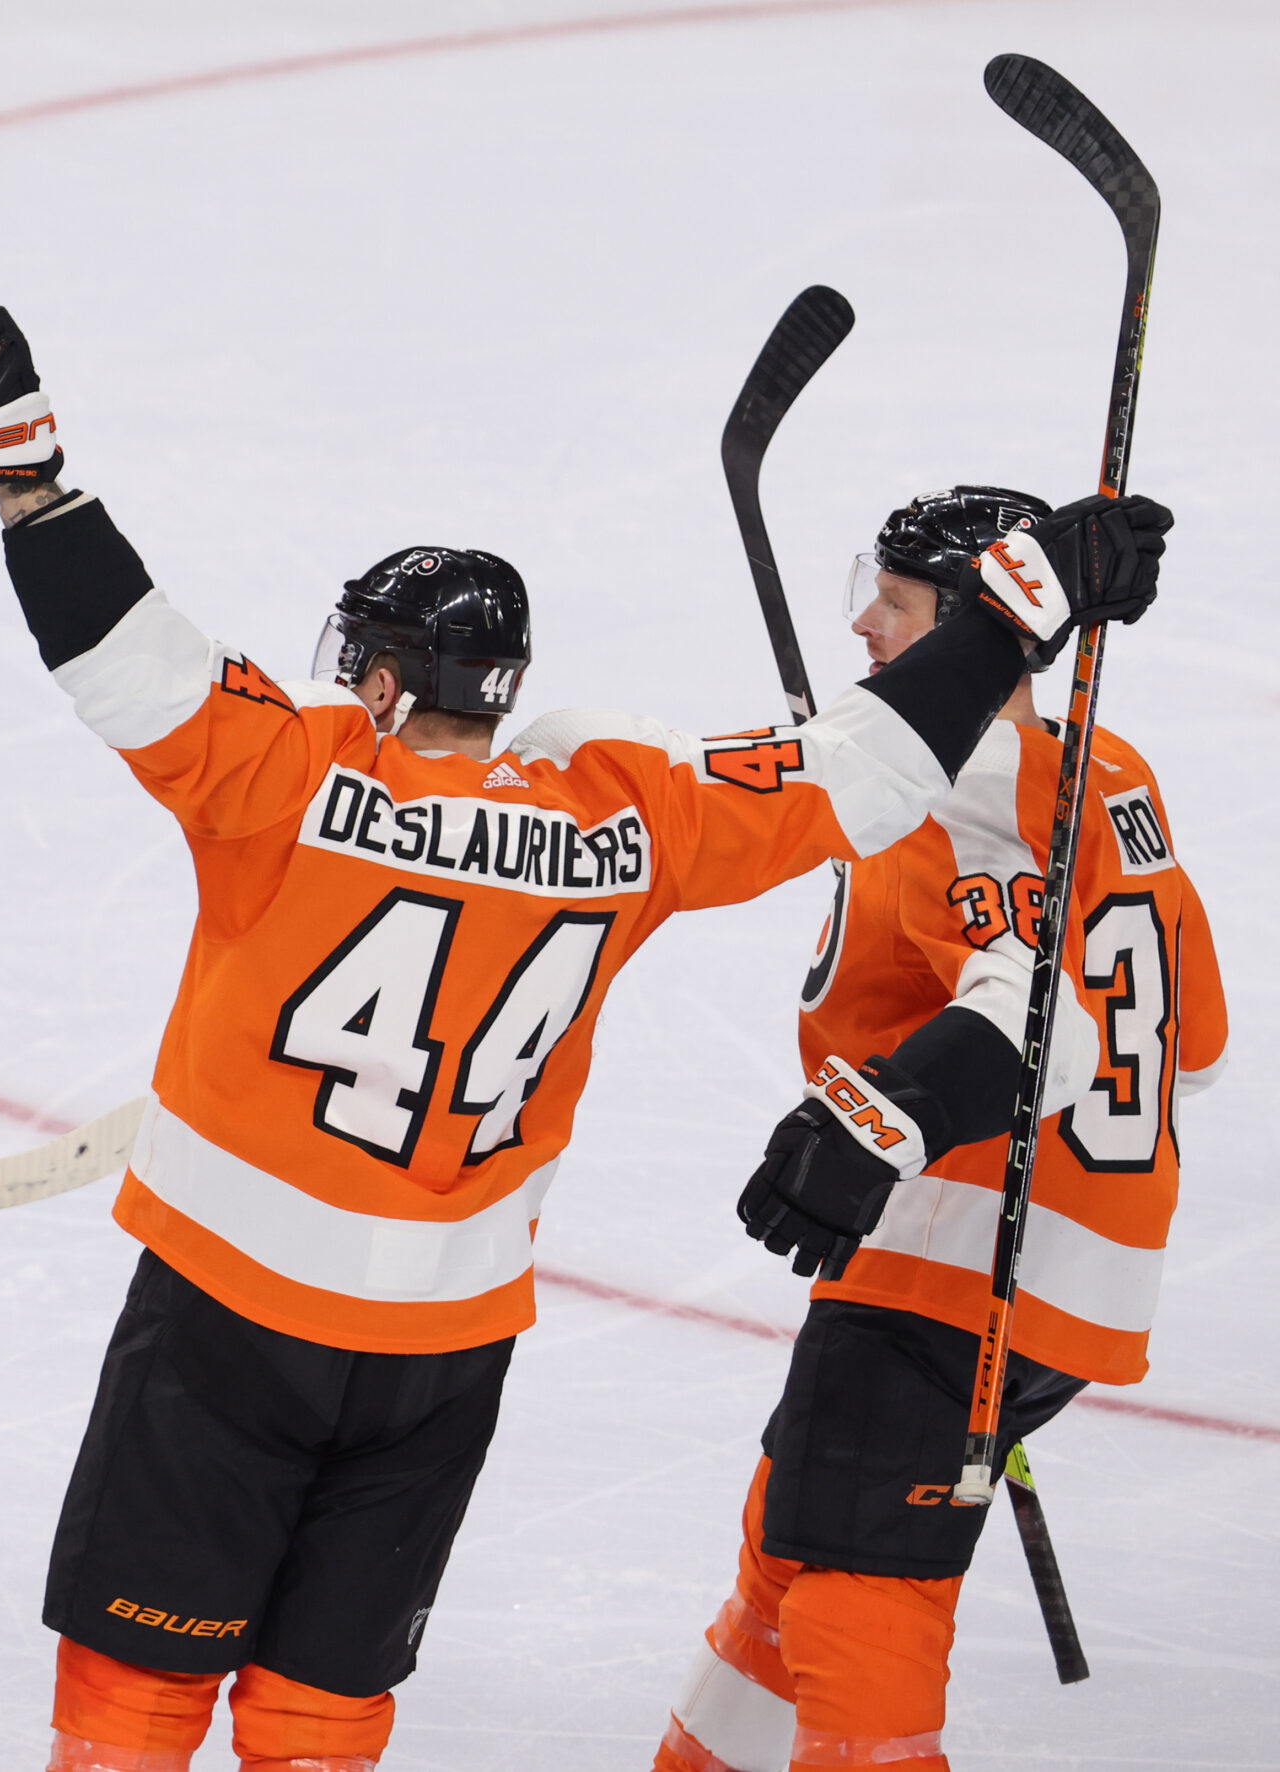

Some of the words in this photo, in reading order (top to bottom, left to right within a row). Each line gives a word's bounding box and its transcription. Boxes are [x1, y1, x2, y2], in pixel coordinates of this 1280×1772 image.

[480, 667, 515, 704] 44
[482, 777, 531, 789] adidas
[319, 773, 642, 888] DESLAURIERS
[946, 871, 1046, 951] 38
[269, 886, 618, 1170] 44
[812, 1061, 907, 1151] CCM
[977, 1310, 999, 1413] TRUE
[107, 1598, 248, 1638] BAUER
